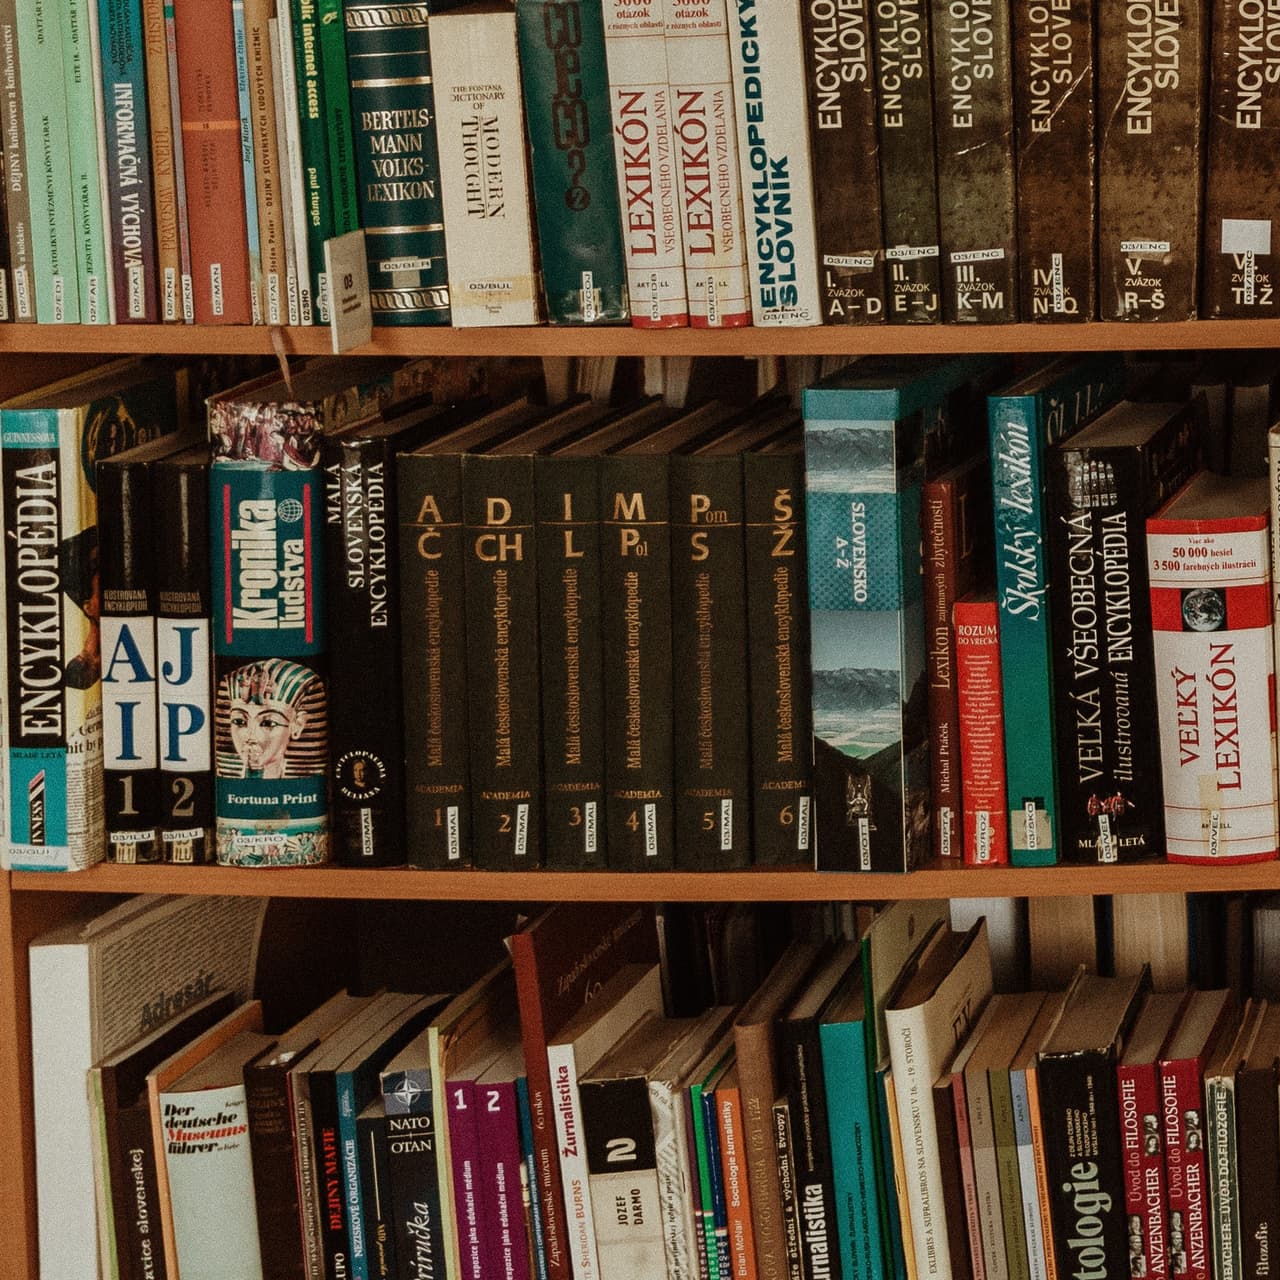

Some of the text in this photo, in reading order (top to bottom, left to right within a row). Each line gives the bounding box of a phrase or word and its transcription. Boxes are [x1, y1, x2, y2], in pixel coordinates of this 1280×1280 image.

[304, 22, 316, 76] internet
[307, 79, 320, 121] access
[370, 134, 424, 154] MANN
[367, 181, 434, 202] LEXIKON
[616, 90, 658, 256] LEXIKÓN
[1000, 421, 1045, 622] Školský lexikón
[231, 498, 278, 630] Kronika
[852, 502, 867, 603] SLOVENSKO
[9, 461, 63, 737] ENCYKLOPÉDIA
[103, 623, 155, 683] A
[163, 627, 199, 686] J
[116, 701, 141, 760] I
[164, 703, 205, 762] P
[1207, 641, 1241, 792] LEXIKÓN
[119, 776, 139, 814] 1
[172, 777, 194, 816] 2
[228, 792, 318, 805] Fortuna Print
[164, 1103, 195, 1116] Der
[165, 1111, 237, 1129] deutsche
[168, 1124, 246, 1141] Museums
[390, 1116, 430, 1131] NATO
[558, 1065, 578, 1158] Žurnalistika
[1122, 1079, 1137, 1149] FILOSOFIE
[391, 1139, 432, 1153] OTAN
[607, 1136, 637, 1161] 2
[616, 1195, 628, 1225] JOZEF
[633, 1188, 645, 1226] DARMO
[1146, 1167, 1164, 1273] ANZENBACHER
